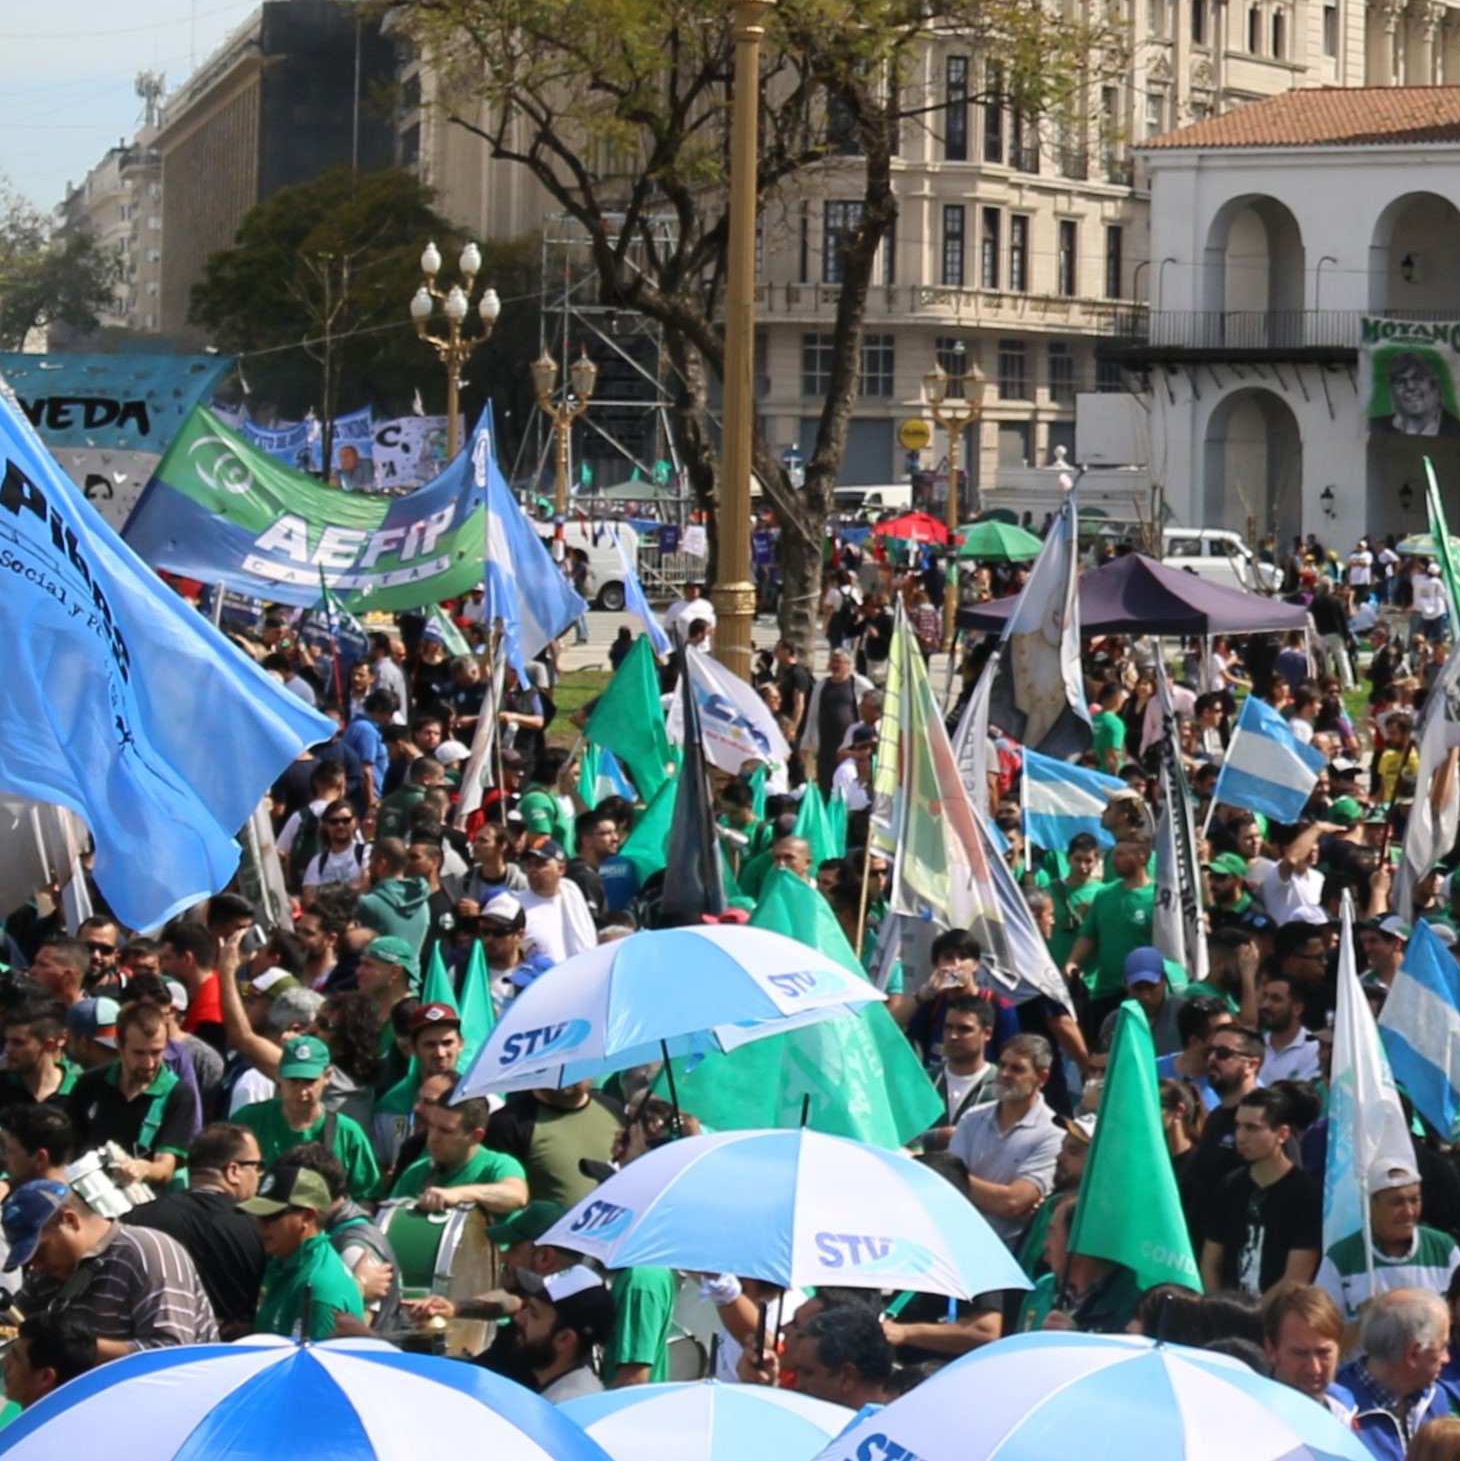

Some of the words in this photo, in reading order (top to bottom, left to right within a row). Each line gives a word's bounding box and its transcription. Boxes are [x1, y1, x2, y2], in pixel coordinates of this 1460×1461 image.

[254, 501, 457, 569] AEFIP
[0, 548, 68, 607] Social
[68, 602, 85, 618] y
[250, 557, 448, 587] CAITAL
[768, 971, 818, 998] STV
[499, 1019, 567, 1065] STV
[570, 1199, 628, 1232] STV
[815, 1231, 894, 1268] STV
